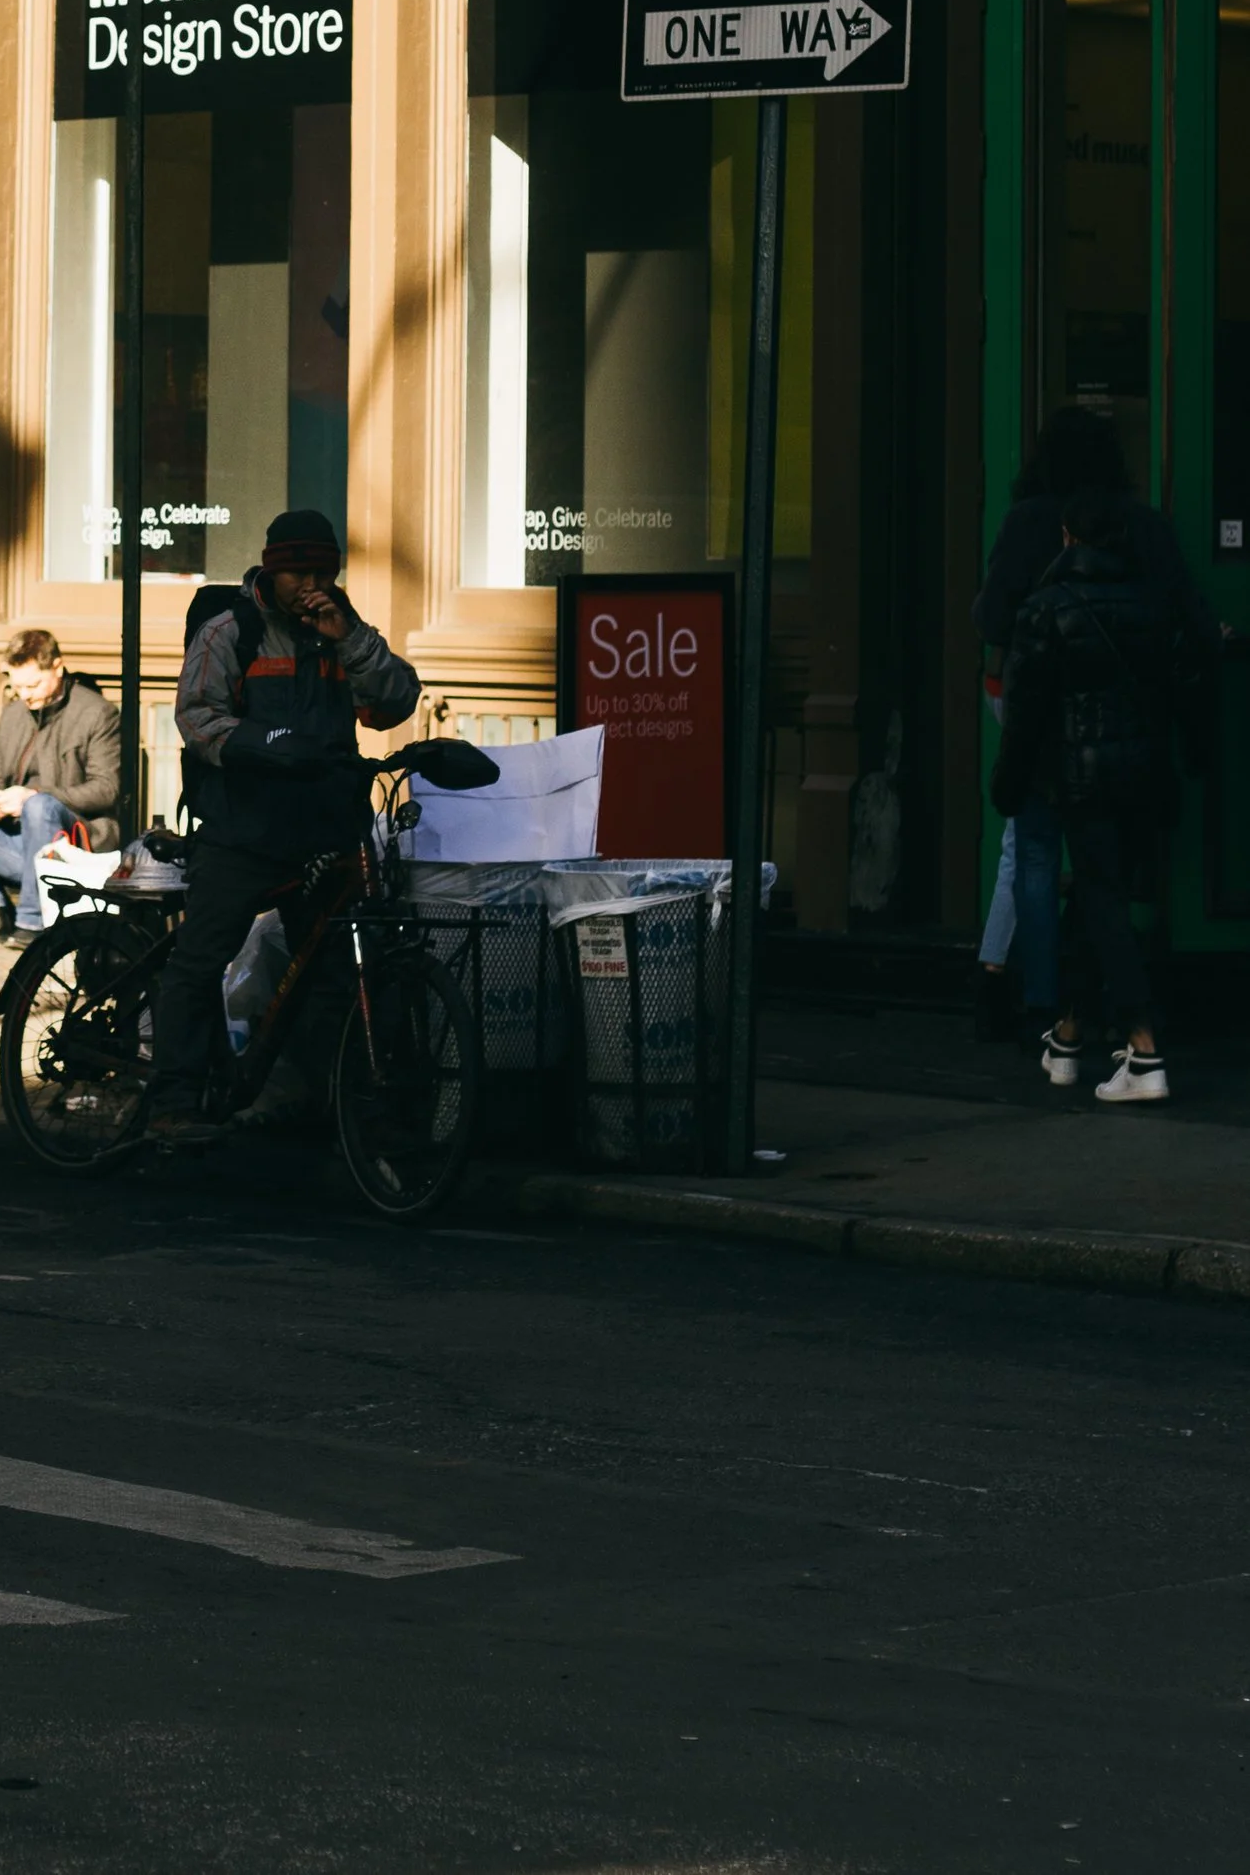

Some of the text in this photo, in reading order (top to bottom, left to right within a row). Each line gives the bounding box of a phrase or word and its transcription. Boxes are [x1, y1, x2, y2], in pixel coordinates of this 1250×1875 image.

[232, 3, 343, 58] Store
[665, 7, 864, 59] ONE WAY
[160, 503, 231, 524] Celebrate
[595, 507, 672, 528] Celebrate
[588, 612, 698, 680] Sale
[586, 690, 690, 717] Up to 30% off
[636, 718, 694, 740] designs
[604, 960, 627, 973] FINE
